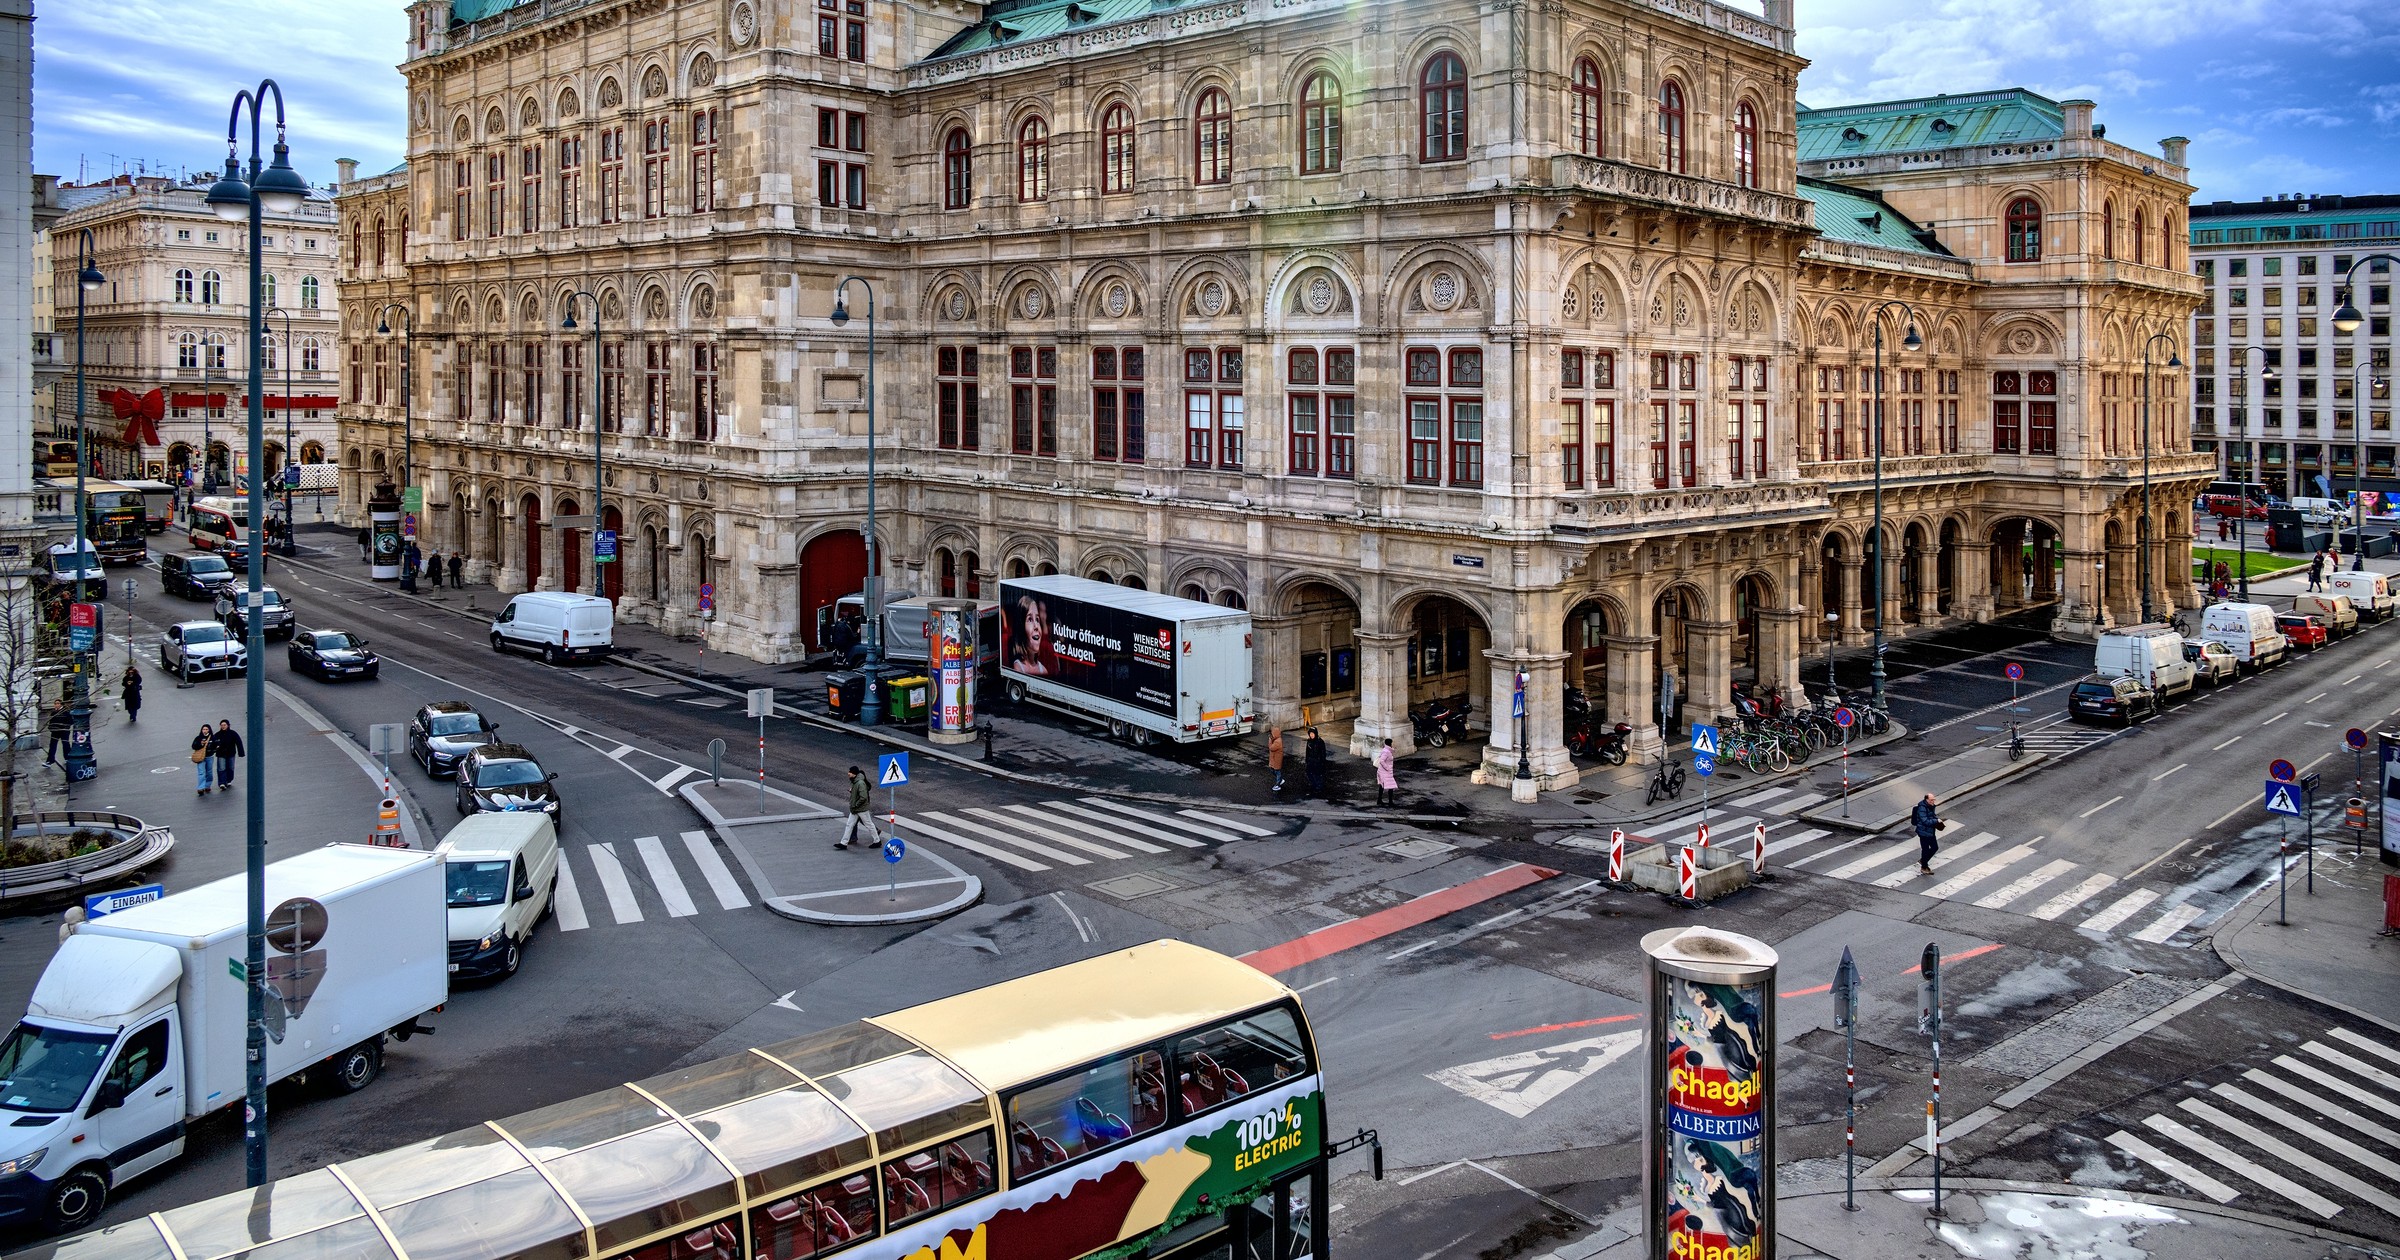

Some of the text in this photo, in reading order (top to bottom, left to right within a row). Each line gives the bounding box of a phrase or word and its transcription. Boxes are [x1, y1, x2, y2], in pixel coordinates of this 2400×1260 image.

[2335, 580, 2351, 589] GO!
[1053, 622, 1122, 652] Kultur öffnet uns
[1133, 632, 1159, 647] WIENER
[1053, 640, 1097, 663] die Augen.
[112, 892, 155, 909] EINBAHN
[1671, 1068, 1762, 1107] Chagall
[1235, 1102, 1302, 1151] 100%
[1672, 1111, 1760, 1136] ALBERTINA
[1234, 1129, 1302, 1172] ELECTRIC
